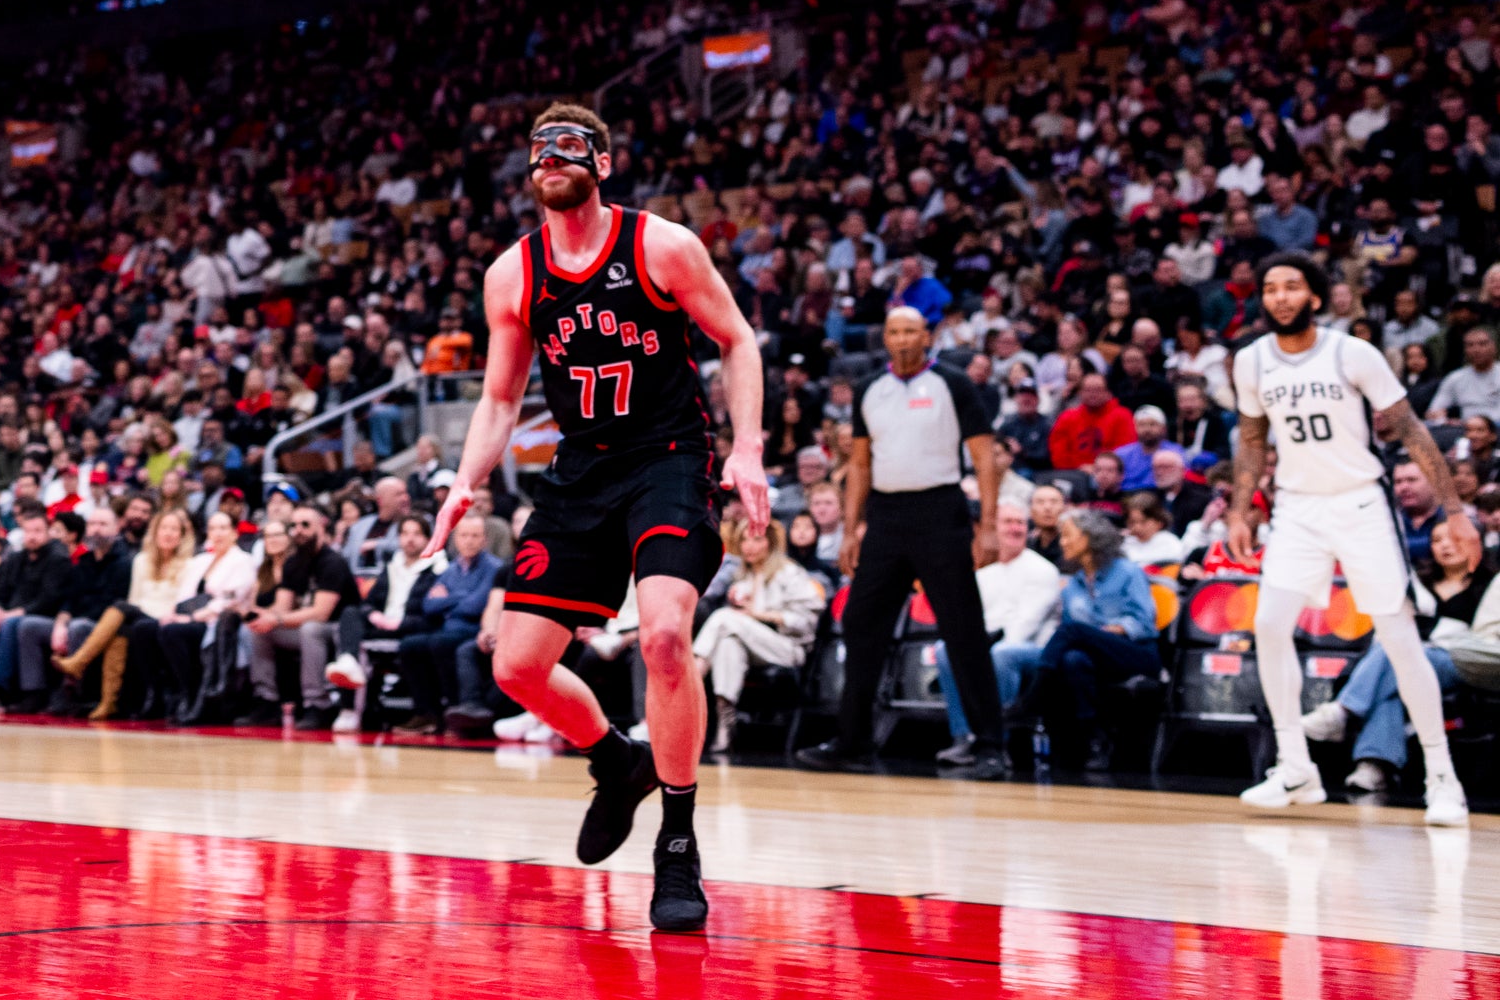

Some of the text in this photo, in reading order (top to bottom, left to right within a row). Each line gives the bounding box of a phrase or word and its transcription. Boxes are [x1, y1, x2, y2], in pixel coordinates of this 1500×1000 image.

[569, 360, 634, 419] 77
[1262, 382, 1344, 408] SPURS
[1285, 412, 1333, 444] 30
